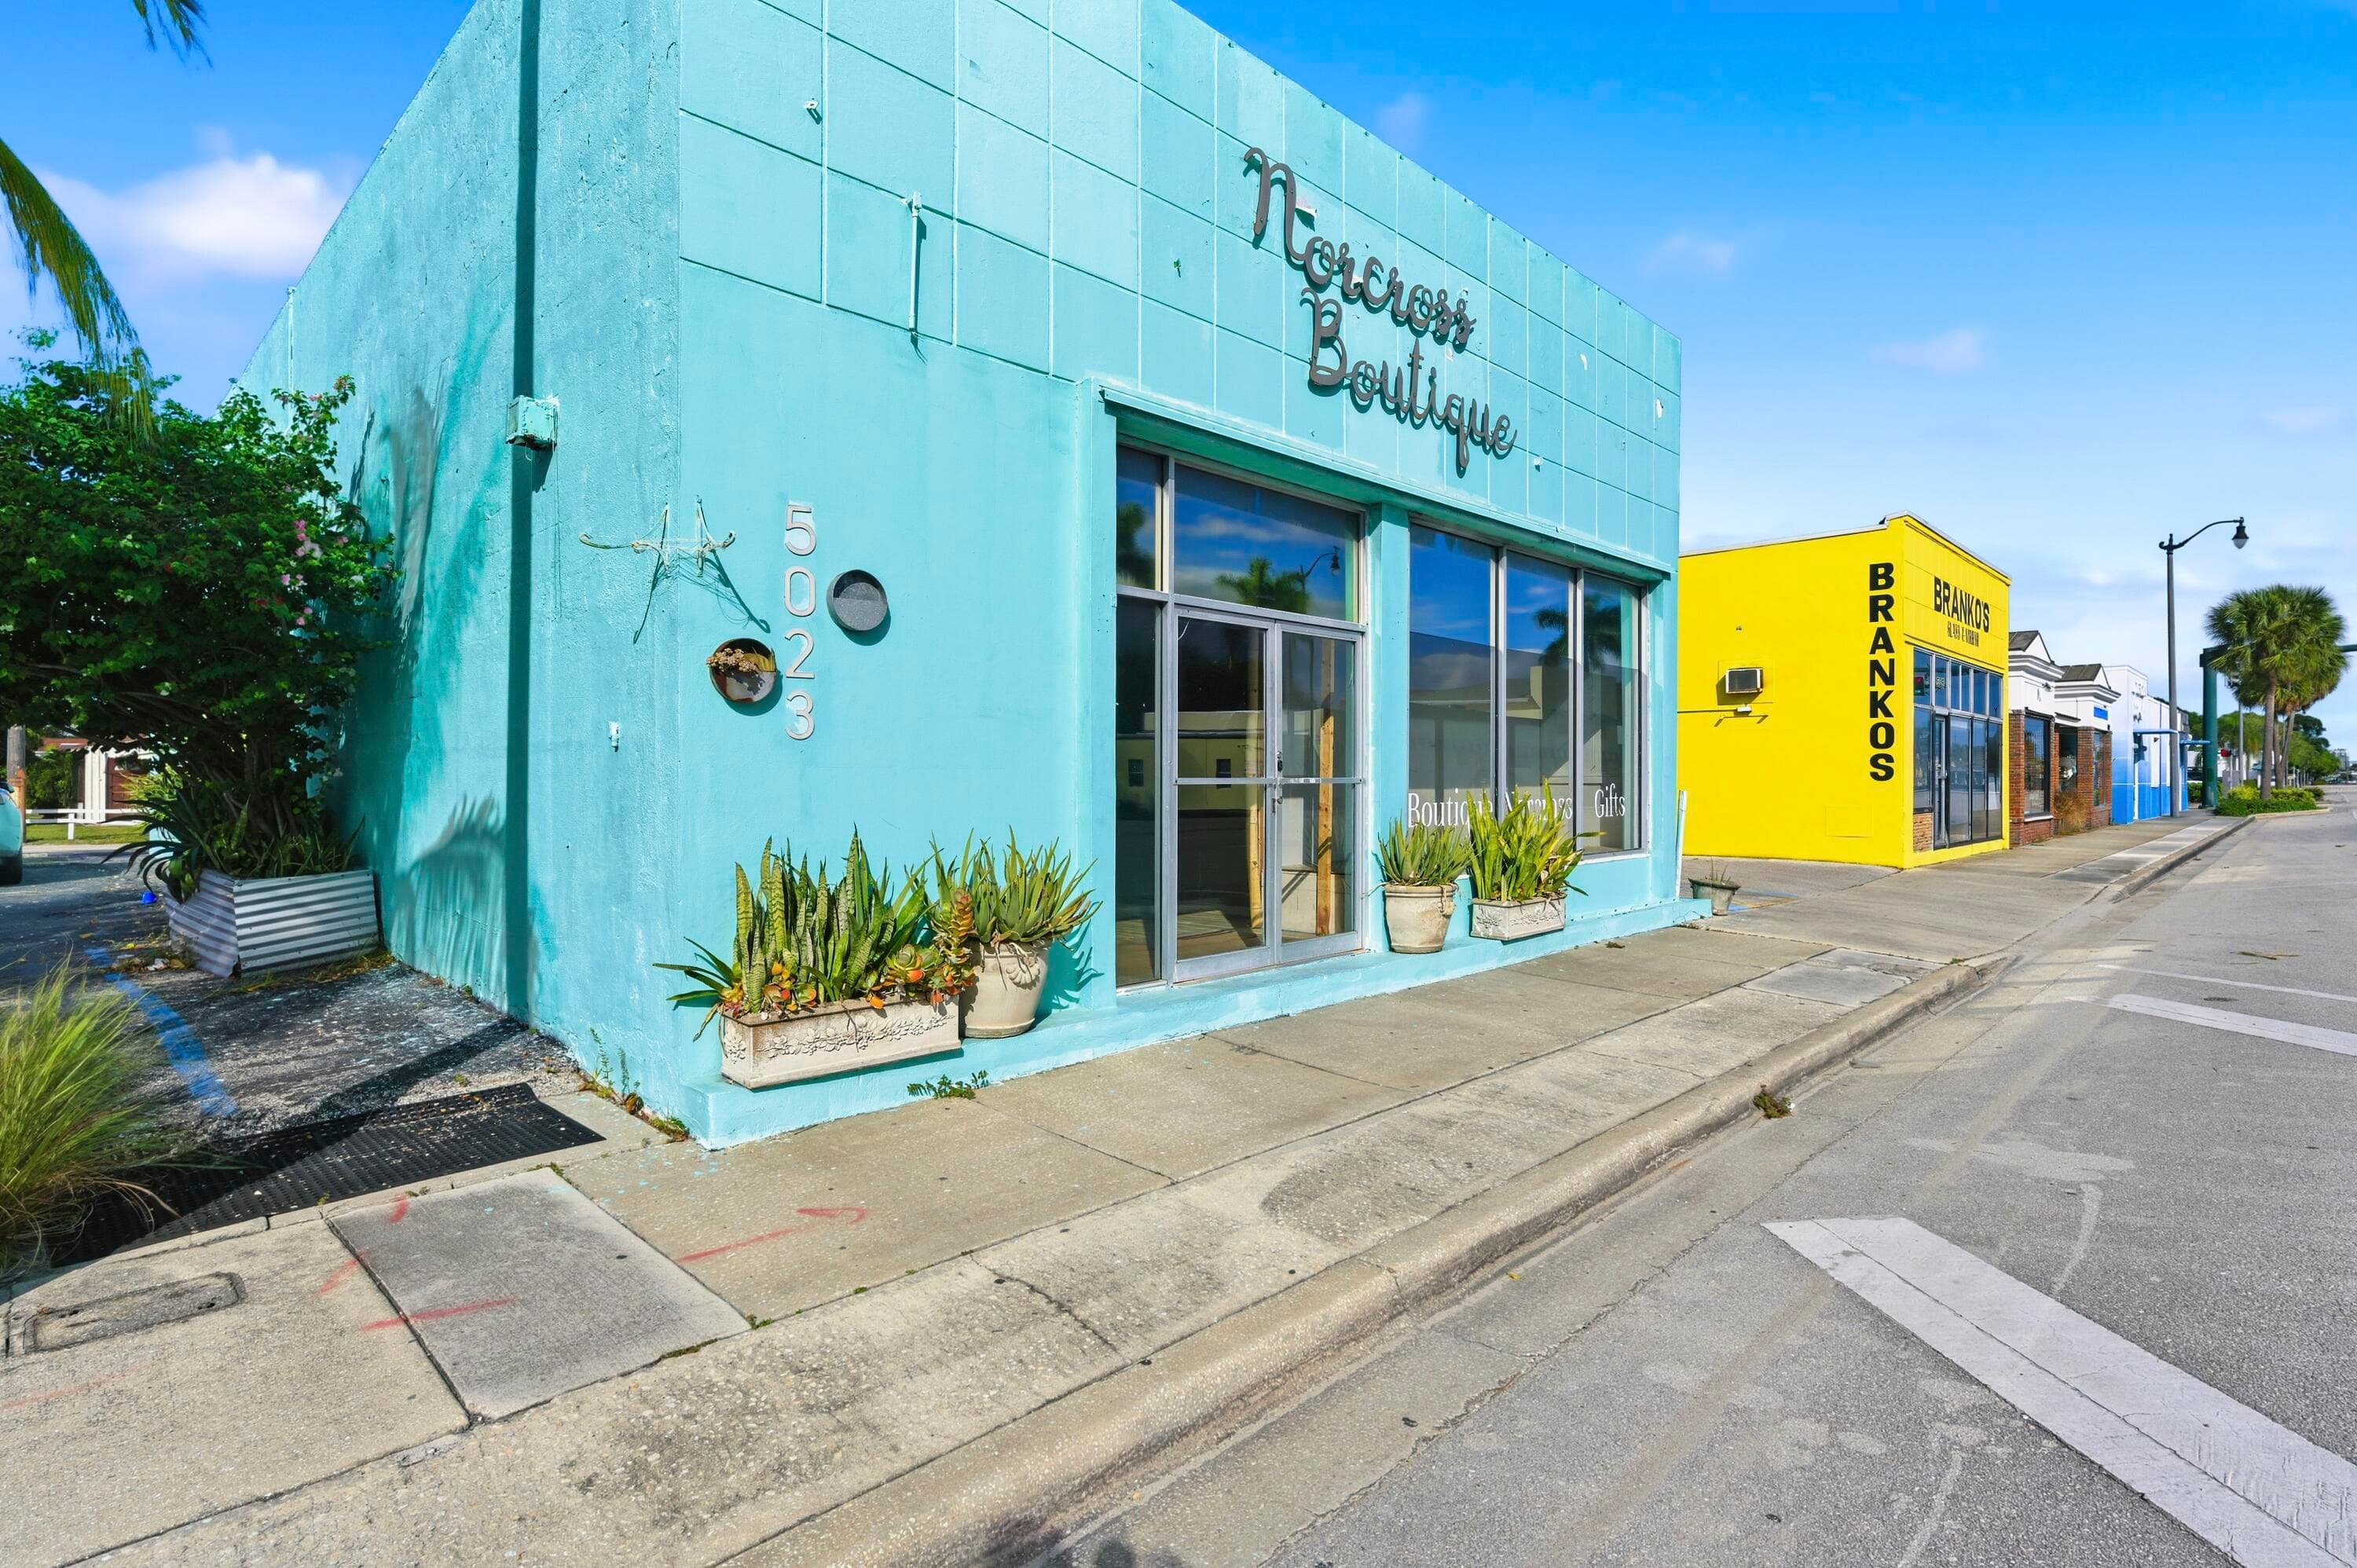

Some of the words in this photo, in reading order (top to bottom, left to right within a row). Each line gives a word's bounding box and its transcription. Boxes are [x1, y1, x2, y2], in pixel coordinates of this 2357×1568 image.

[1244, 147, 1477, 344] Norcross
[1301, 288, 1518, 469] Boutique
[784, 503, 817, 741] 5023
[1869, 562, 1895, 782] BRANKOS
[1934, 575, 1990, 633] BRANKO'S
[1594, 782, 1626, 818] Gifts
